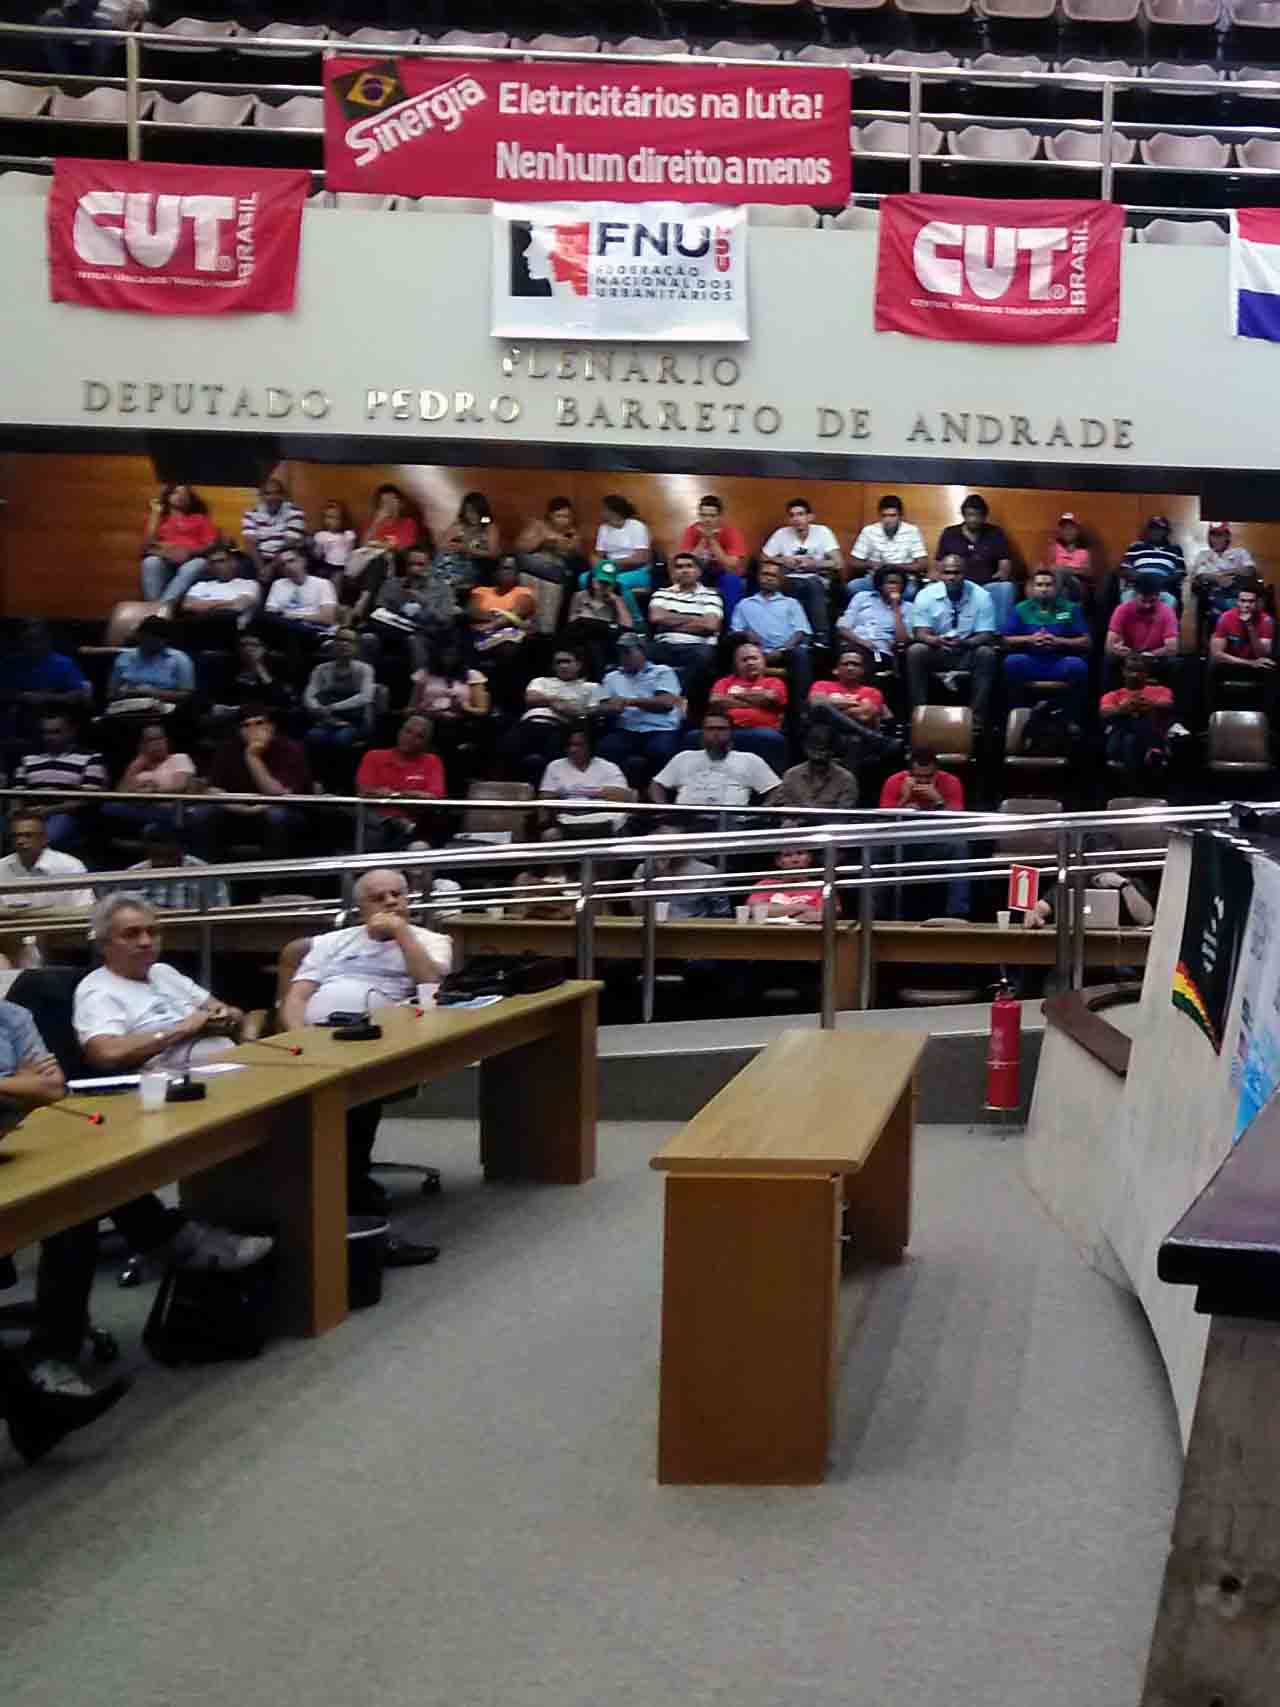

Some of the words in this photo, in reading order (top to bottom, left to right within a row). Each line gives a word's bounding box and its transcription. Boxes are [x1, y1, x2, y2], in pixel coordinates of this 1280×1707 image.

[345, 73, 487, 167] Sinergia
[499, 82, 696, 118] Eletricitários
[700, 94, 740, 119] na
[746, 87, 824, 121] luta!
[496, 141, 625, 182] Nenhum
[627, 146, 727, 184] direito
[725, 158, 744, 185] a
[747, 156, 833, 185] menos
[73, 191, 236, 271] CUT
[236, 191, 258, 281] BRASIL
[597, 221, 711, 258] FNU
[913, 220, 1069, 300] CUT
[1069, 219, 1090, 305] BRASIL
[82, 378, 330, 419] DEPUTADO
[366, 387, 520, 423] PEDRO
[555, 395, 782, 435] BARRETO
[816, 407, 873, 440] DE
[905, 412, 1135, 449] ANDRADE
